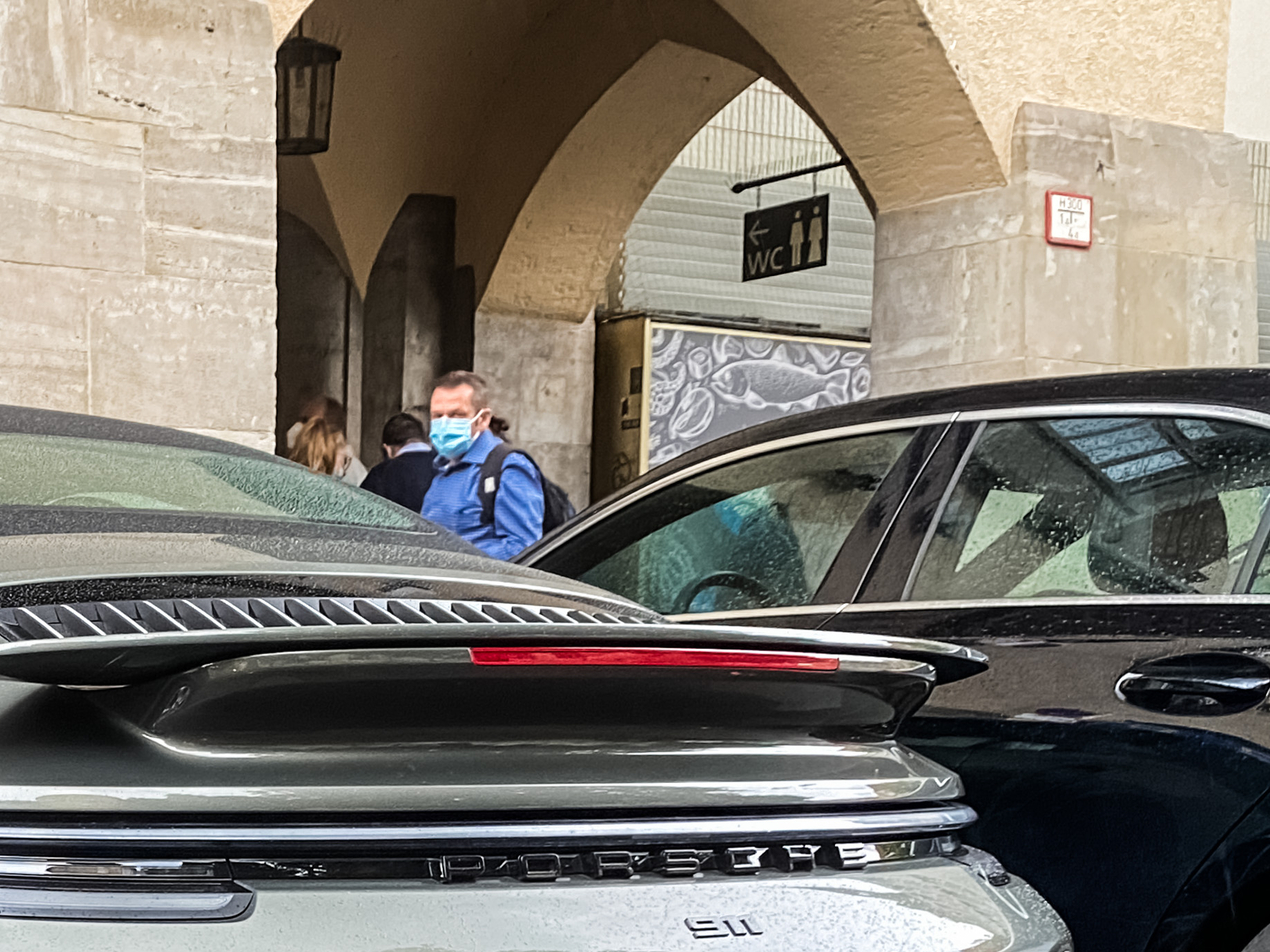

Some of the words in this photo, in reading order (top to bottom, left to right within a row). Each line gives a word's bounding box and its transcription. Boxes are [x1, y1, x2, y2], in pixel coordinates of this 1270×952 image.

[747, 245, 784, 275] WC
[441, 843, 867, 882] PORSCHE
[684, 914, 764, 939] 911
